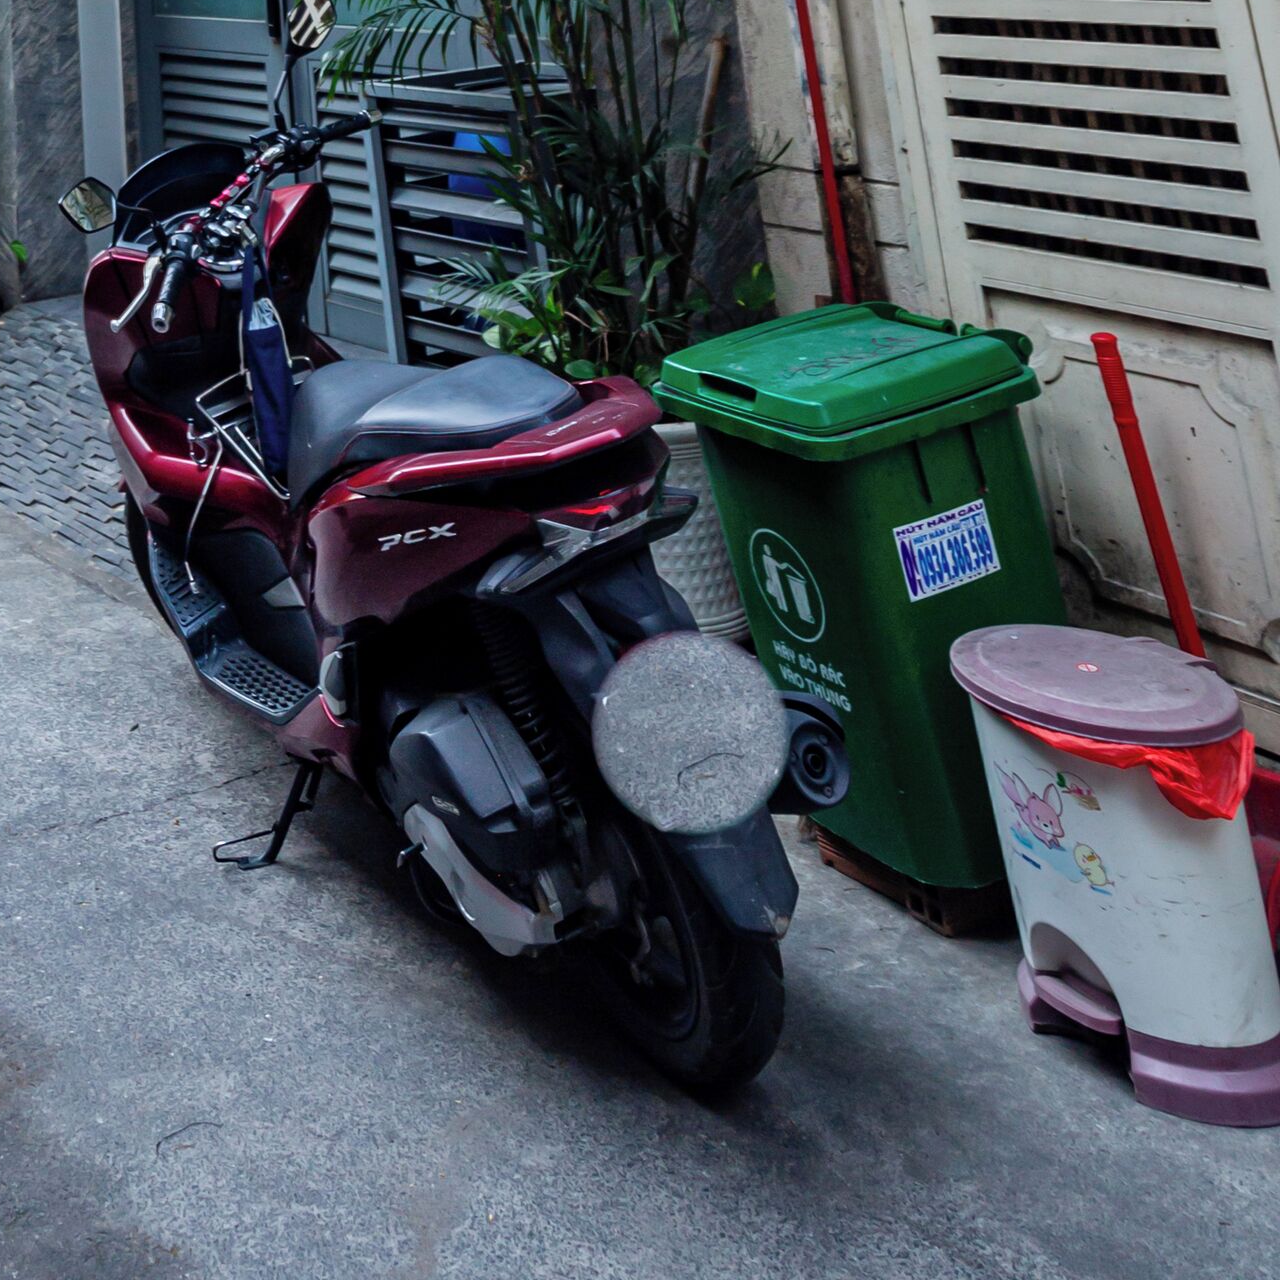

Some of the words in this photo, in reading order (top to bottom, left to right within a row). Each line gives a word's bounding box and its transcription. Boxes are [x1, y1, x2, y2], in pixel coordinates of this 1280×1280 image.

[377, 522, 457, 552] PCX
[819, 662, 846, 688] RÁC
[804, 677, 852, 712] THÙNG
